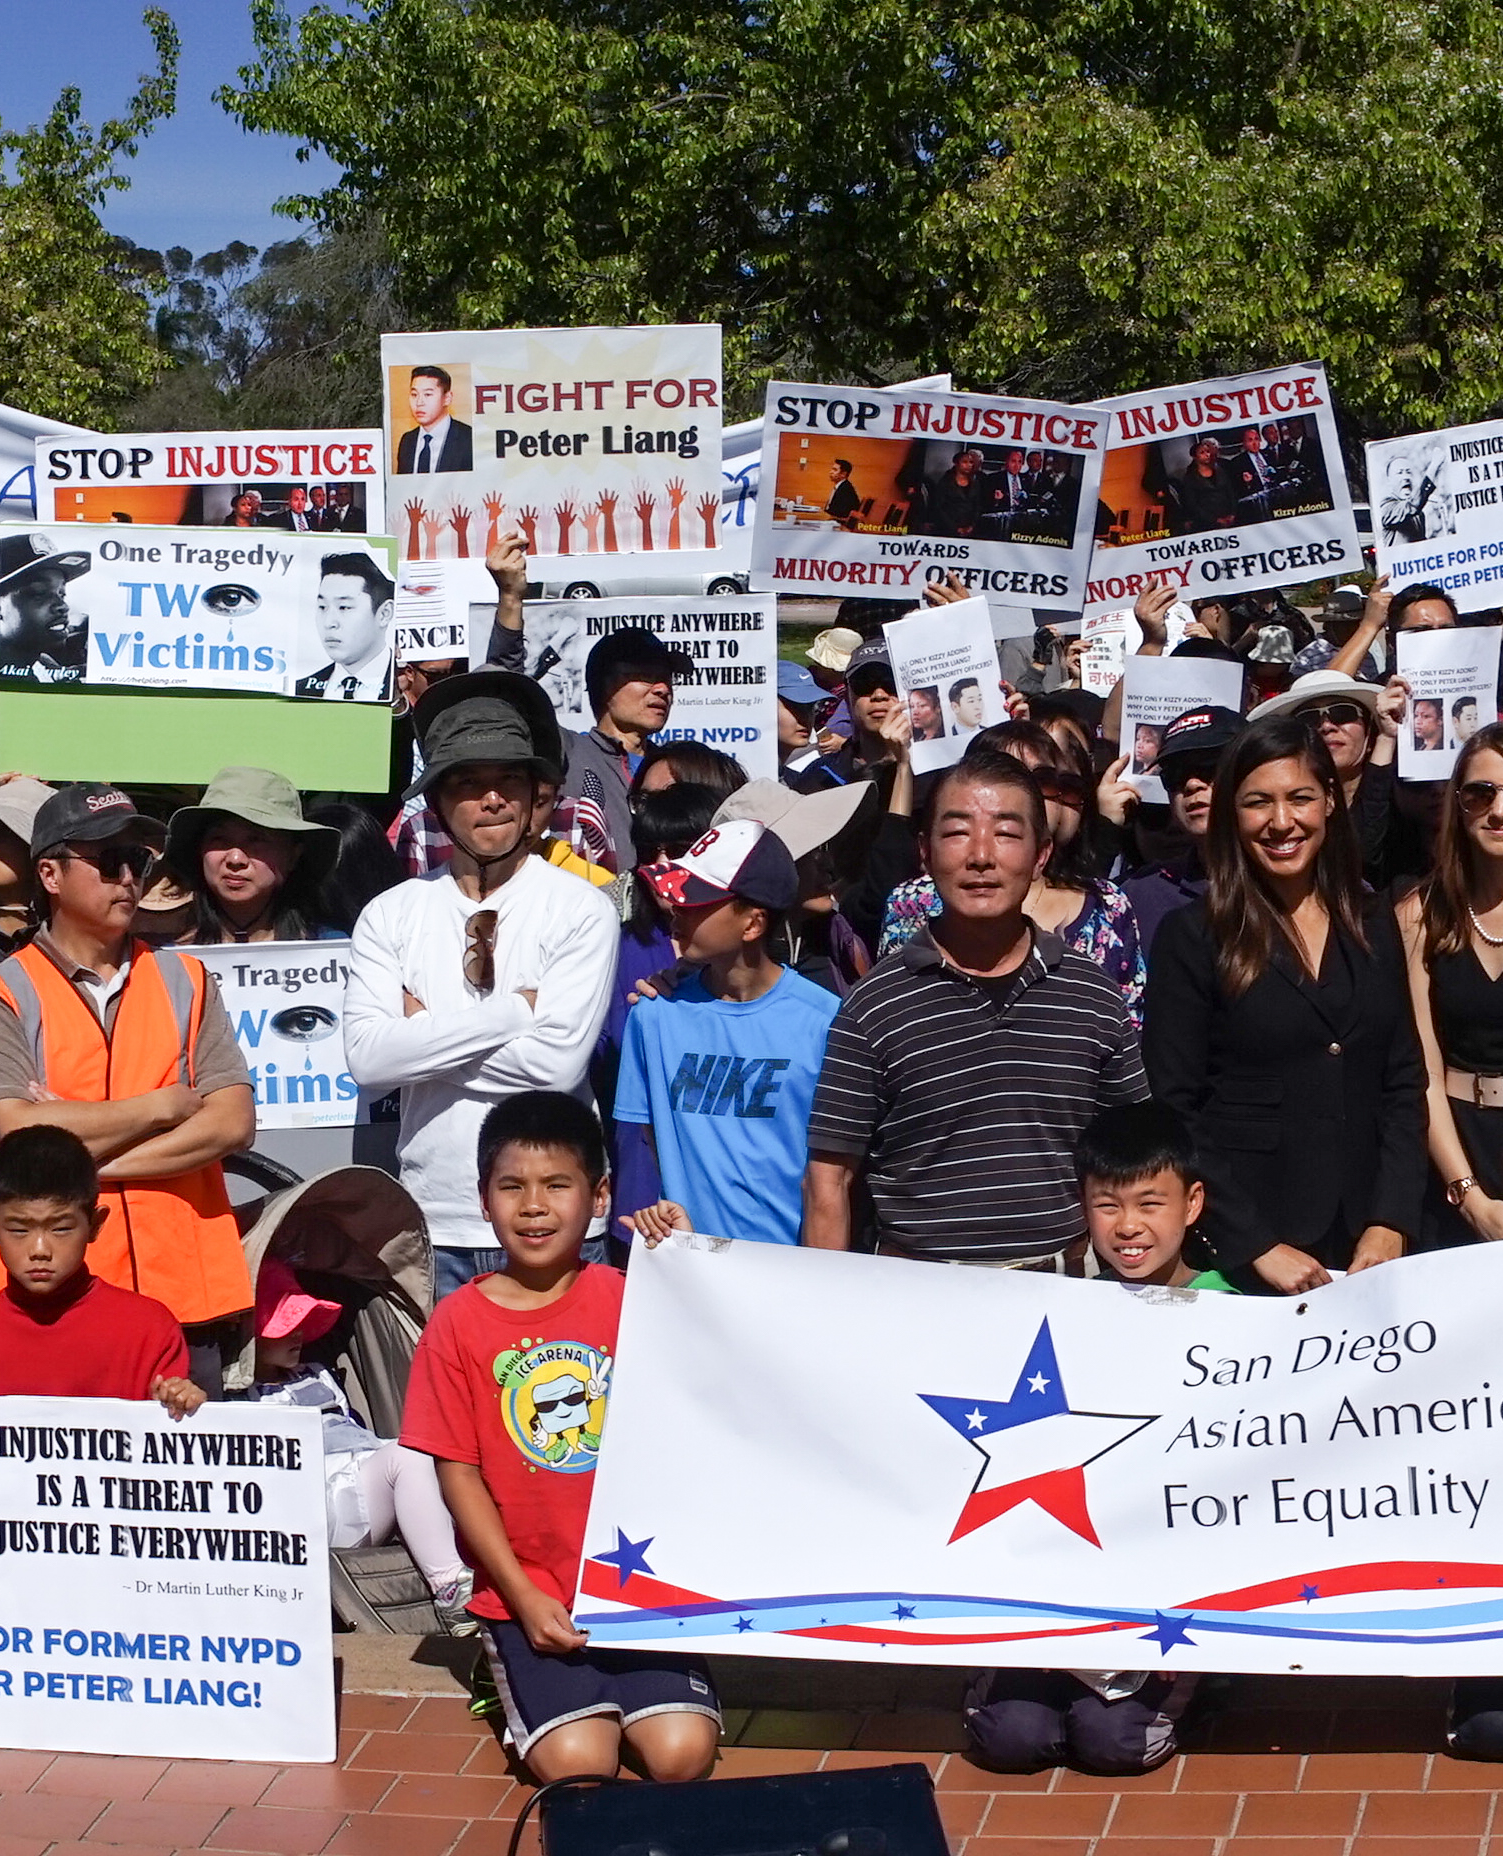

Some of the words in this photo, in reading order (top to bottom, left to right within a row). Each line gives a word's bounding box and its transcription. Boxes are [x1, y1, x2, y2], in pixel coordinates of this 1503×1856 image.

[474, 380, 614, 415] FIGHT
[627, 378, 718, 409] FOR
[1117, 376, 1324, 440] INJUSTICE
[775, 396, 881, 431] STOP
[891, 402, 1098, 449] INJUSTICE
[497, 429, 590, 459] Peter
[602, 425, 700, 459] Liang
[48, 448, 153, 481] STOP
[165, 443, 376, 478] INJUSTICE
[1469, 467, 1480, 484] IS
[1483, 465, 1491, 481] A
[1273, 506, 1297, 518] Kizzy
[1298, 500, 1329, 513] Adonis
[1455, 489, 1498, 513] JUSTICE
[857, 521, 881, 533] Peter
[884, 523, 908, 535] Liang
[1011, 532, 1034, 544] Kizzy
[1120, 532, 1144, 544] Peter
[99, 539, 162, 564] One
[879, 540, 969, 559] TOWARDS
[1147, 535, 1240, 562] TOWARDS
[1201, 539, 1346, 582] OFFICERS
[1392, 554, 1444, 579] JUSTICE
[1448, 548, 1476, 567] FOR
[773, 557, 921, 586] MINORITY
[671, 612, 764, 632] ANYWHERE
[717, 641, 739, 657] TO
[702, 727, 761, 743] NYPD
[668, 1052, 791, 1120] NIKE
[505, 1351, 527, 1371] DIEGO
[515, 1358, 535, 1379] ICE
[537, 1348, 583, 1365] ARENA
[1182, 1344, 1273, 1389] San
[1291, 1320, 1438, 1374] Diego
[1165, 1408, 1308, 1453] Asian
[142, 1431, 303, 1471] ANYWHERE
[36, 1474, 62, 1507] IS
[72, 1480, 90, 1508] A
[99, 1477, 214, 1514] THREAT
[223, 1481, 263, 1515] TO
[1163, 1483, 1249, 1528] For
[1271, 1465, 1490, 1538] Equality
[110, 1525, 308, 1566] EVERYWHERE
[135, 1580, 154, 1595] Dr
[157, 1581, 202, 1596] Martin
[205, 1582, 250, 1597] Luther
[253, 1584, 288, 1601] King
[290, 1586, 304, 1601] Jr
[43, 1628, 191, 1662] FORMER
[201, 1635, 302, 1667] NYPD
[23, 1670, 134, 1703] PETER
[143, 1677, 263, 1709] LIANG!
